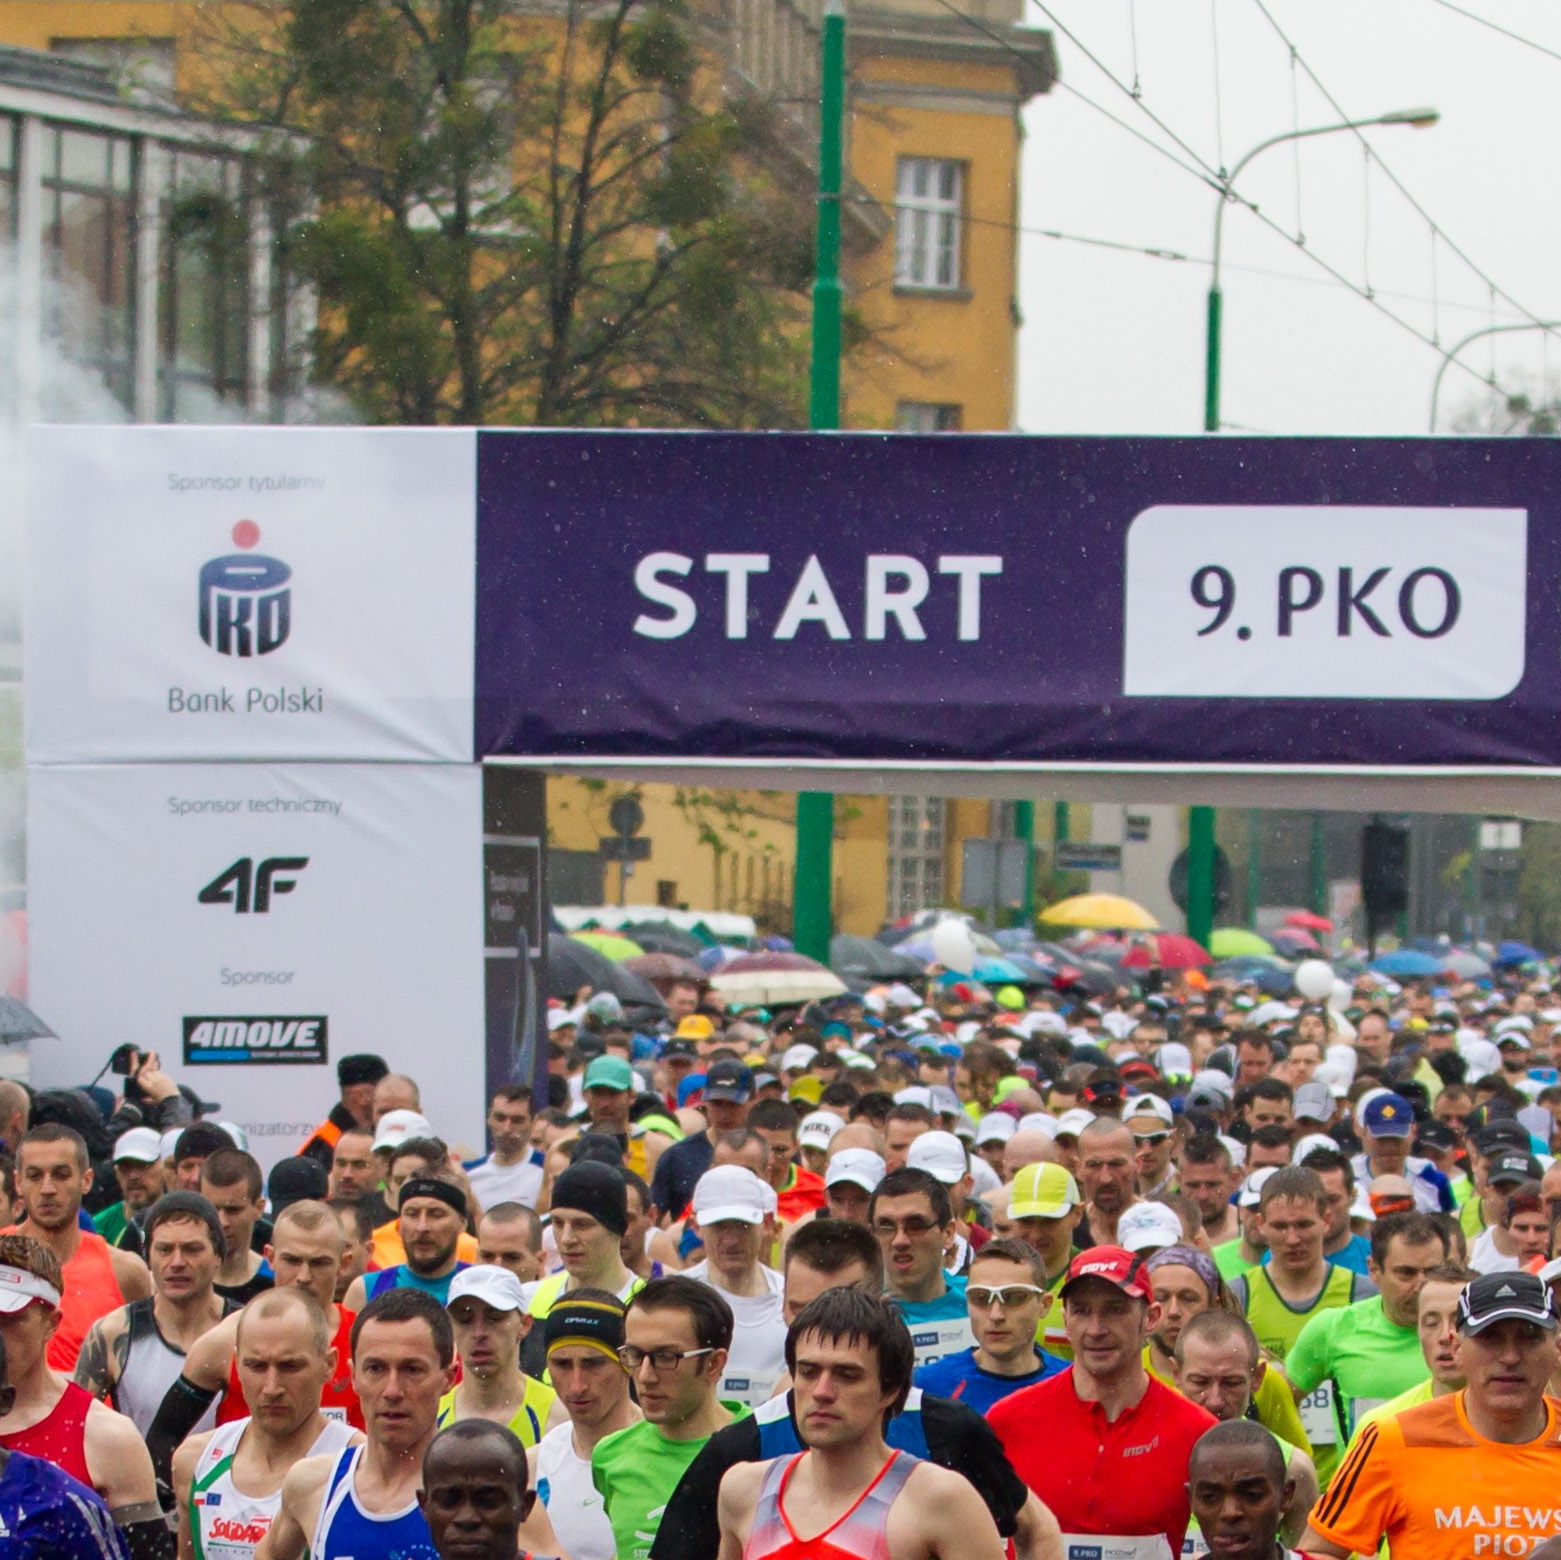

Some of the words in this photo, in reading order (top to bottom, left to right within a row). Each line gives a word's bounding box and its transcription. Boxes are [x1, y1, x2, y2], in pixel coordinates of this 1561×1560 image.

[168, 472, 243, 493] Sponsor
[633, 552, 1004, 642] START
[168, 686, 235, 713] Bank
[246, 686, 323, 713] Polski
[168, 797, 243, 817] Sponsor
[248, 796, 343, 817] techniczny
[197, 856, 309, 913] 4F
[220, 967, 295, 988] Sponsor
